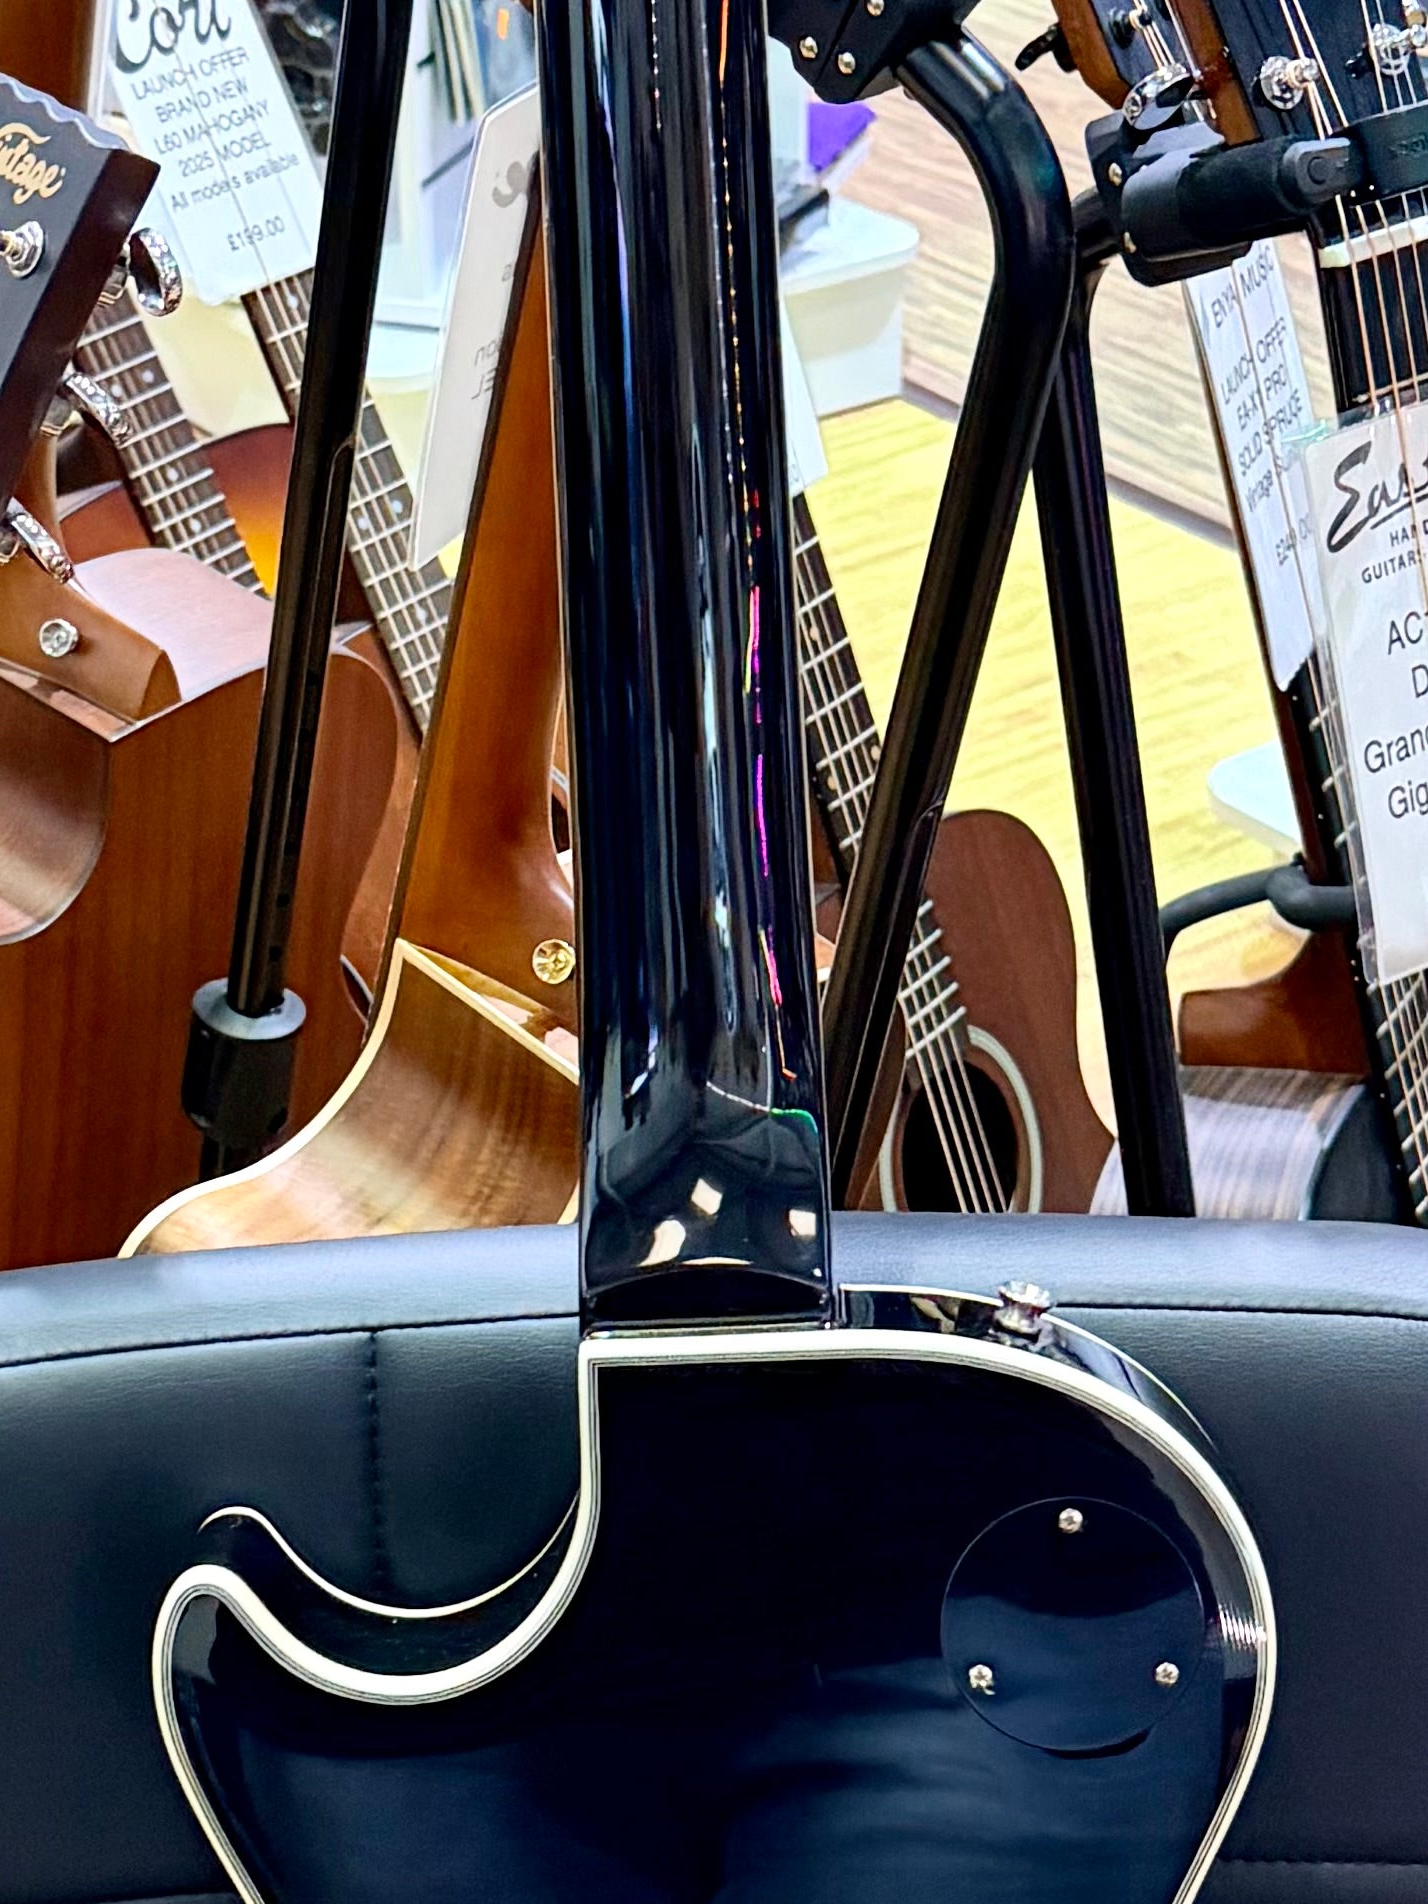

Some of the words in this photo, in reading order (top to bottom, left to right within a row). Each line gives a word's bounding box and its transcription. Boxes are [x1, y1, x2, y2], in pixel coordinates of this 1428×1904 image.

[131, 64, 198, 101] LAUNCH
[199, 46, 251, 79] OFFER
[213, 78, 249, 105] NEW
[177, 152, 216, 178] 2025
[1239, 245, 1274, 296] MUSIC
[1361, 548, 1426, 584] GUITARS
